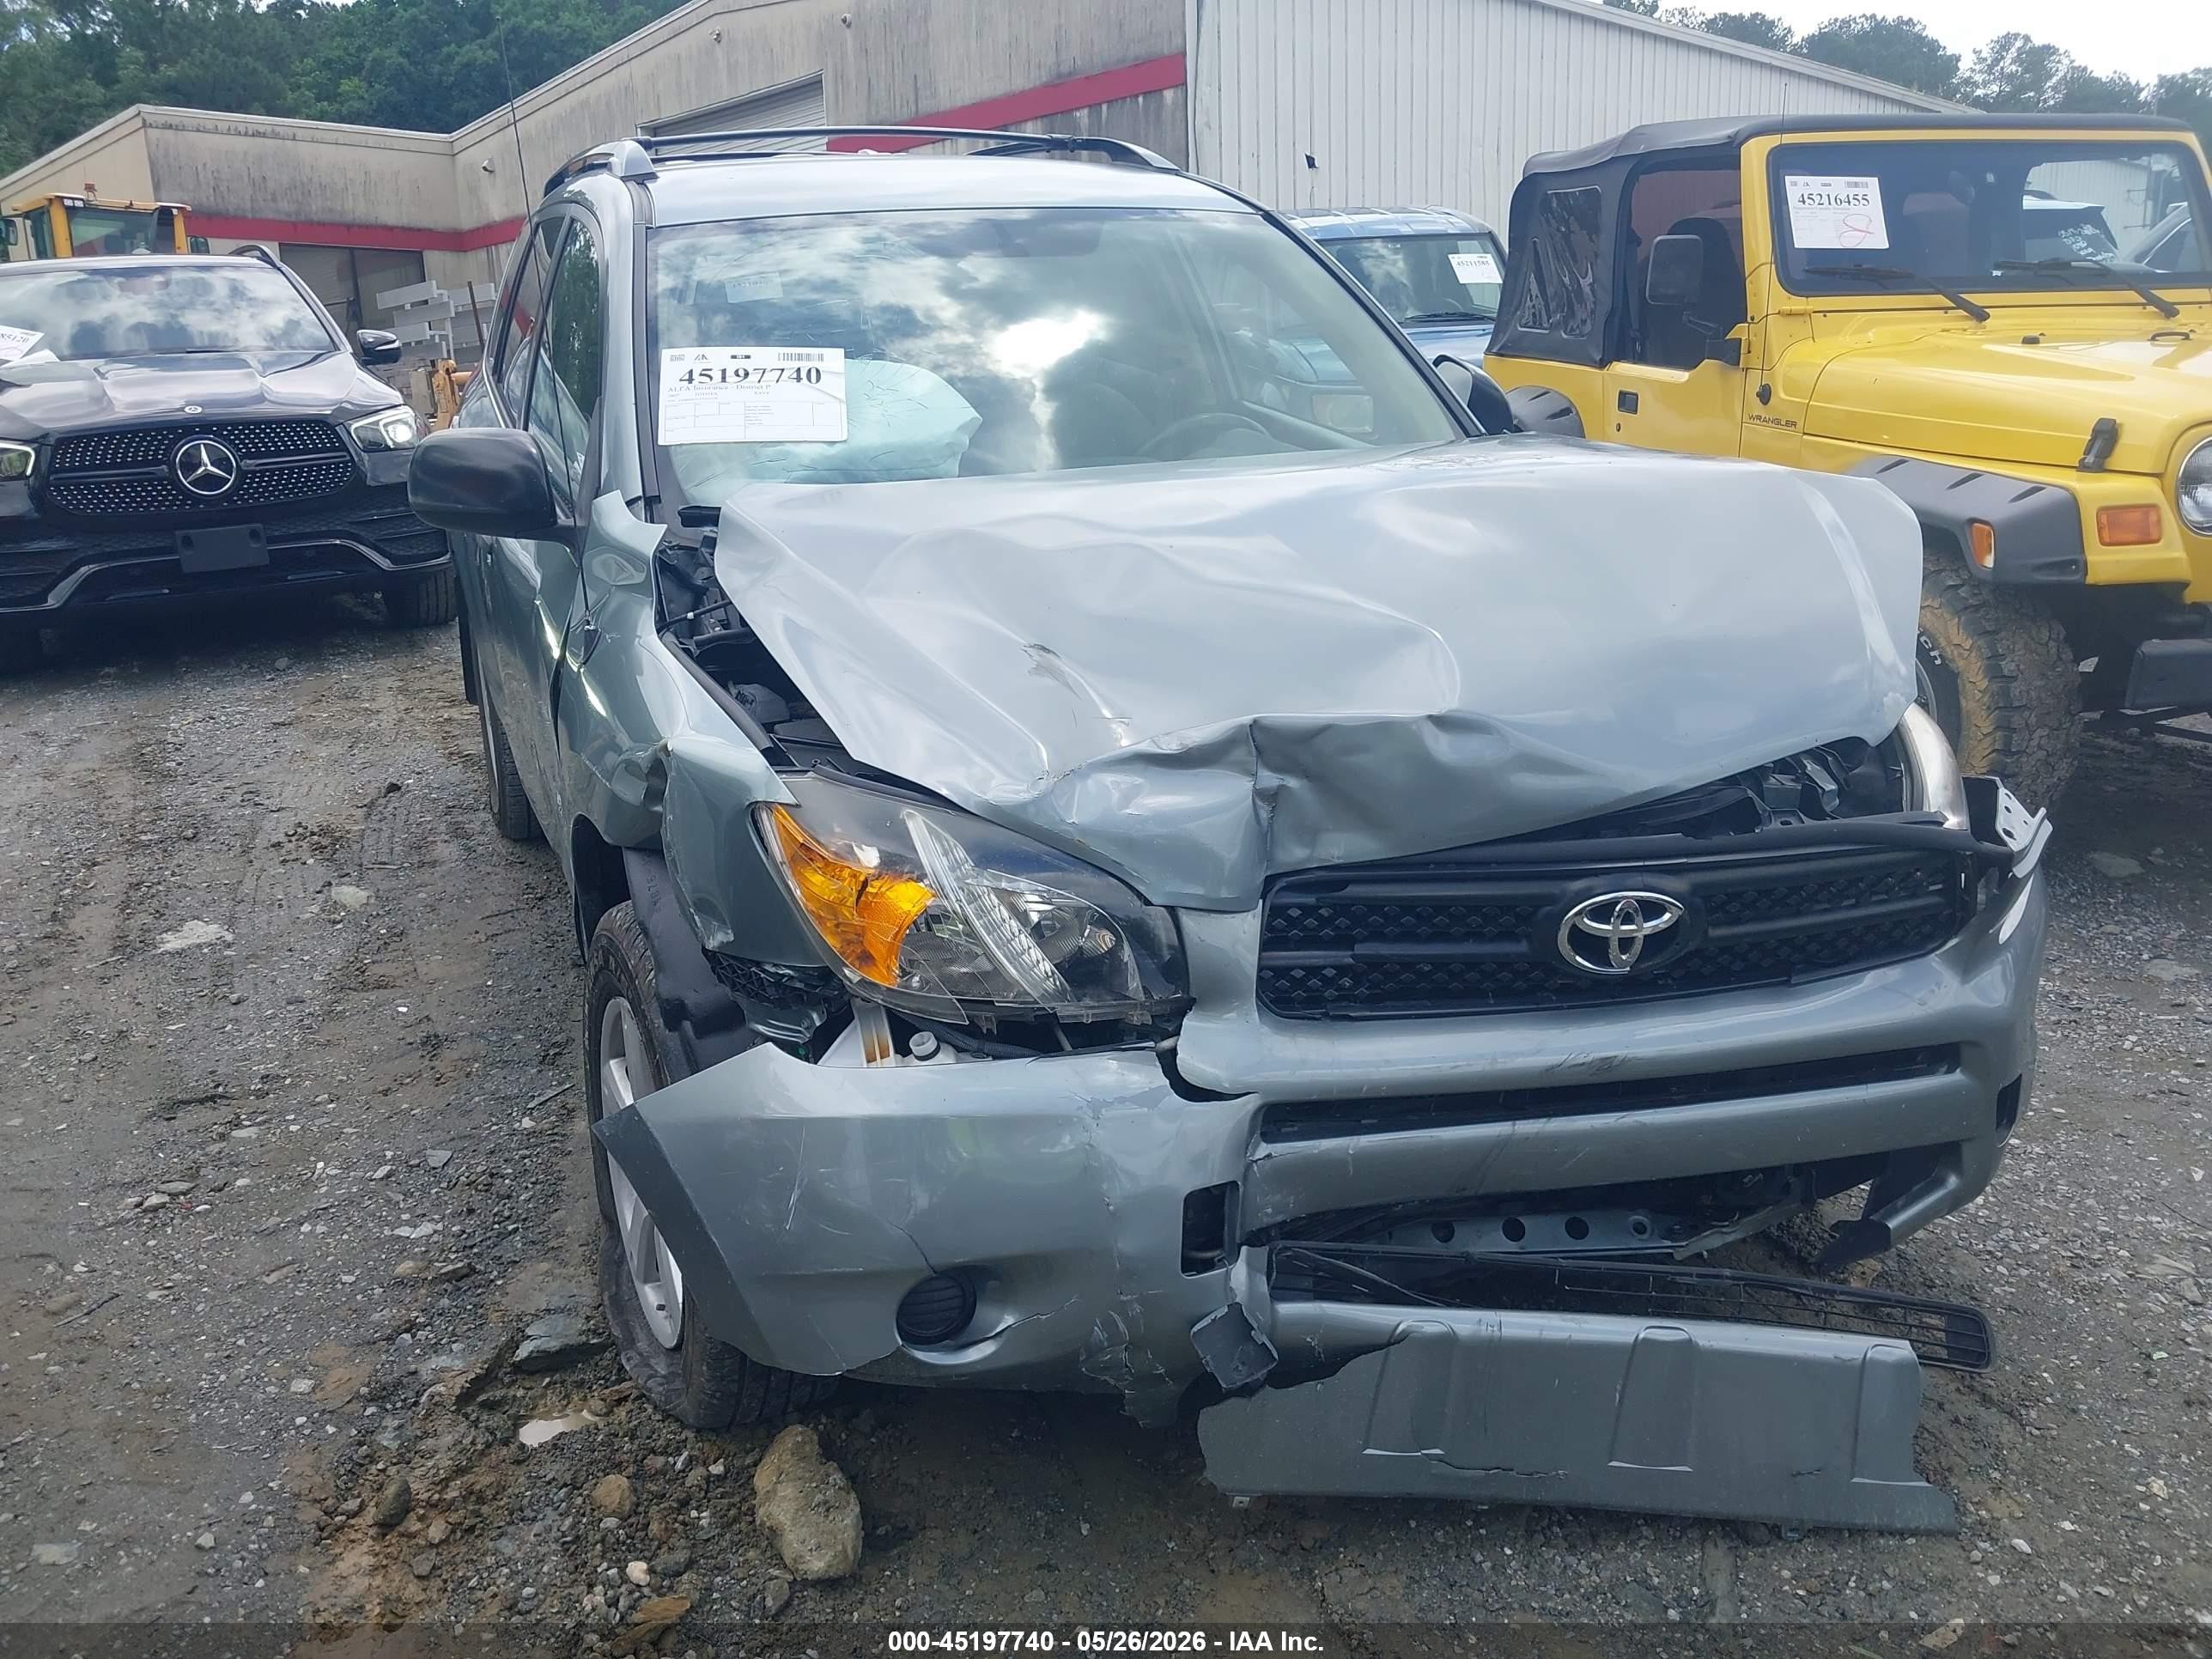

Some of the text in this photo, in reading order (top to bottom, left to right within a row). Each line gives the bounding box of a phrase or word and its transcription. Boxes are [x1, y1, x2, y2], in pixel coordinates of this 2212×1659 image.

[1798, 192, 1870, 207] 45216455
[679, 367, 822, 385] 45197740
[1748, 413, 1798, 428] WRANGLER
